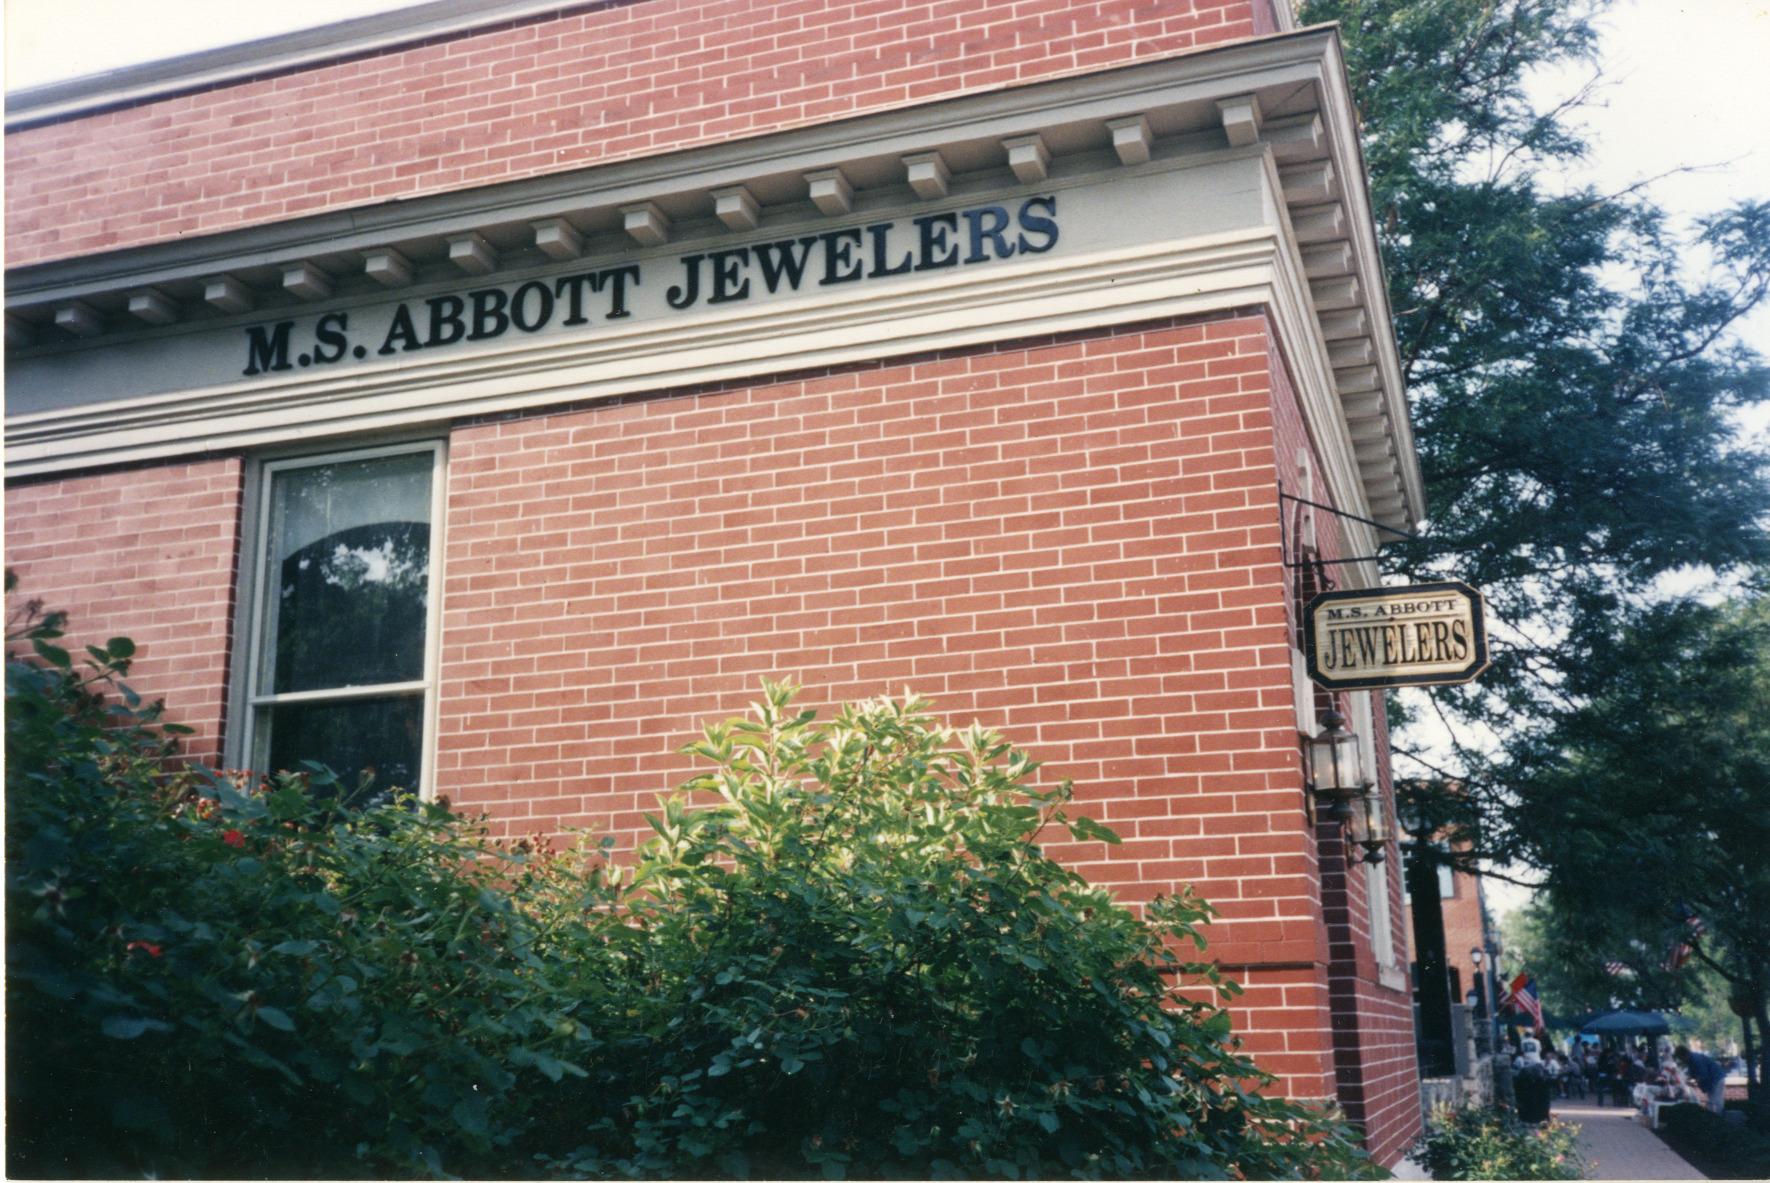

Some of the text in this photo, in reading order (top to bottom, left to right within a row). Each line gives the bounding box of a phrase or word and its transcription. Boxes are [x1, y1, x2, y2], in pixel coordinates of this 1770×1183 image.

[242, 195, 1060, 376] M.S. ABBOTT JEWELERS
[1328, 600, 1456, 619] M.S. ABBOTT
[1325, 620, 1467, 669] JEWELERS
